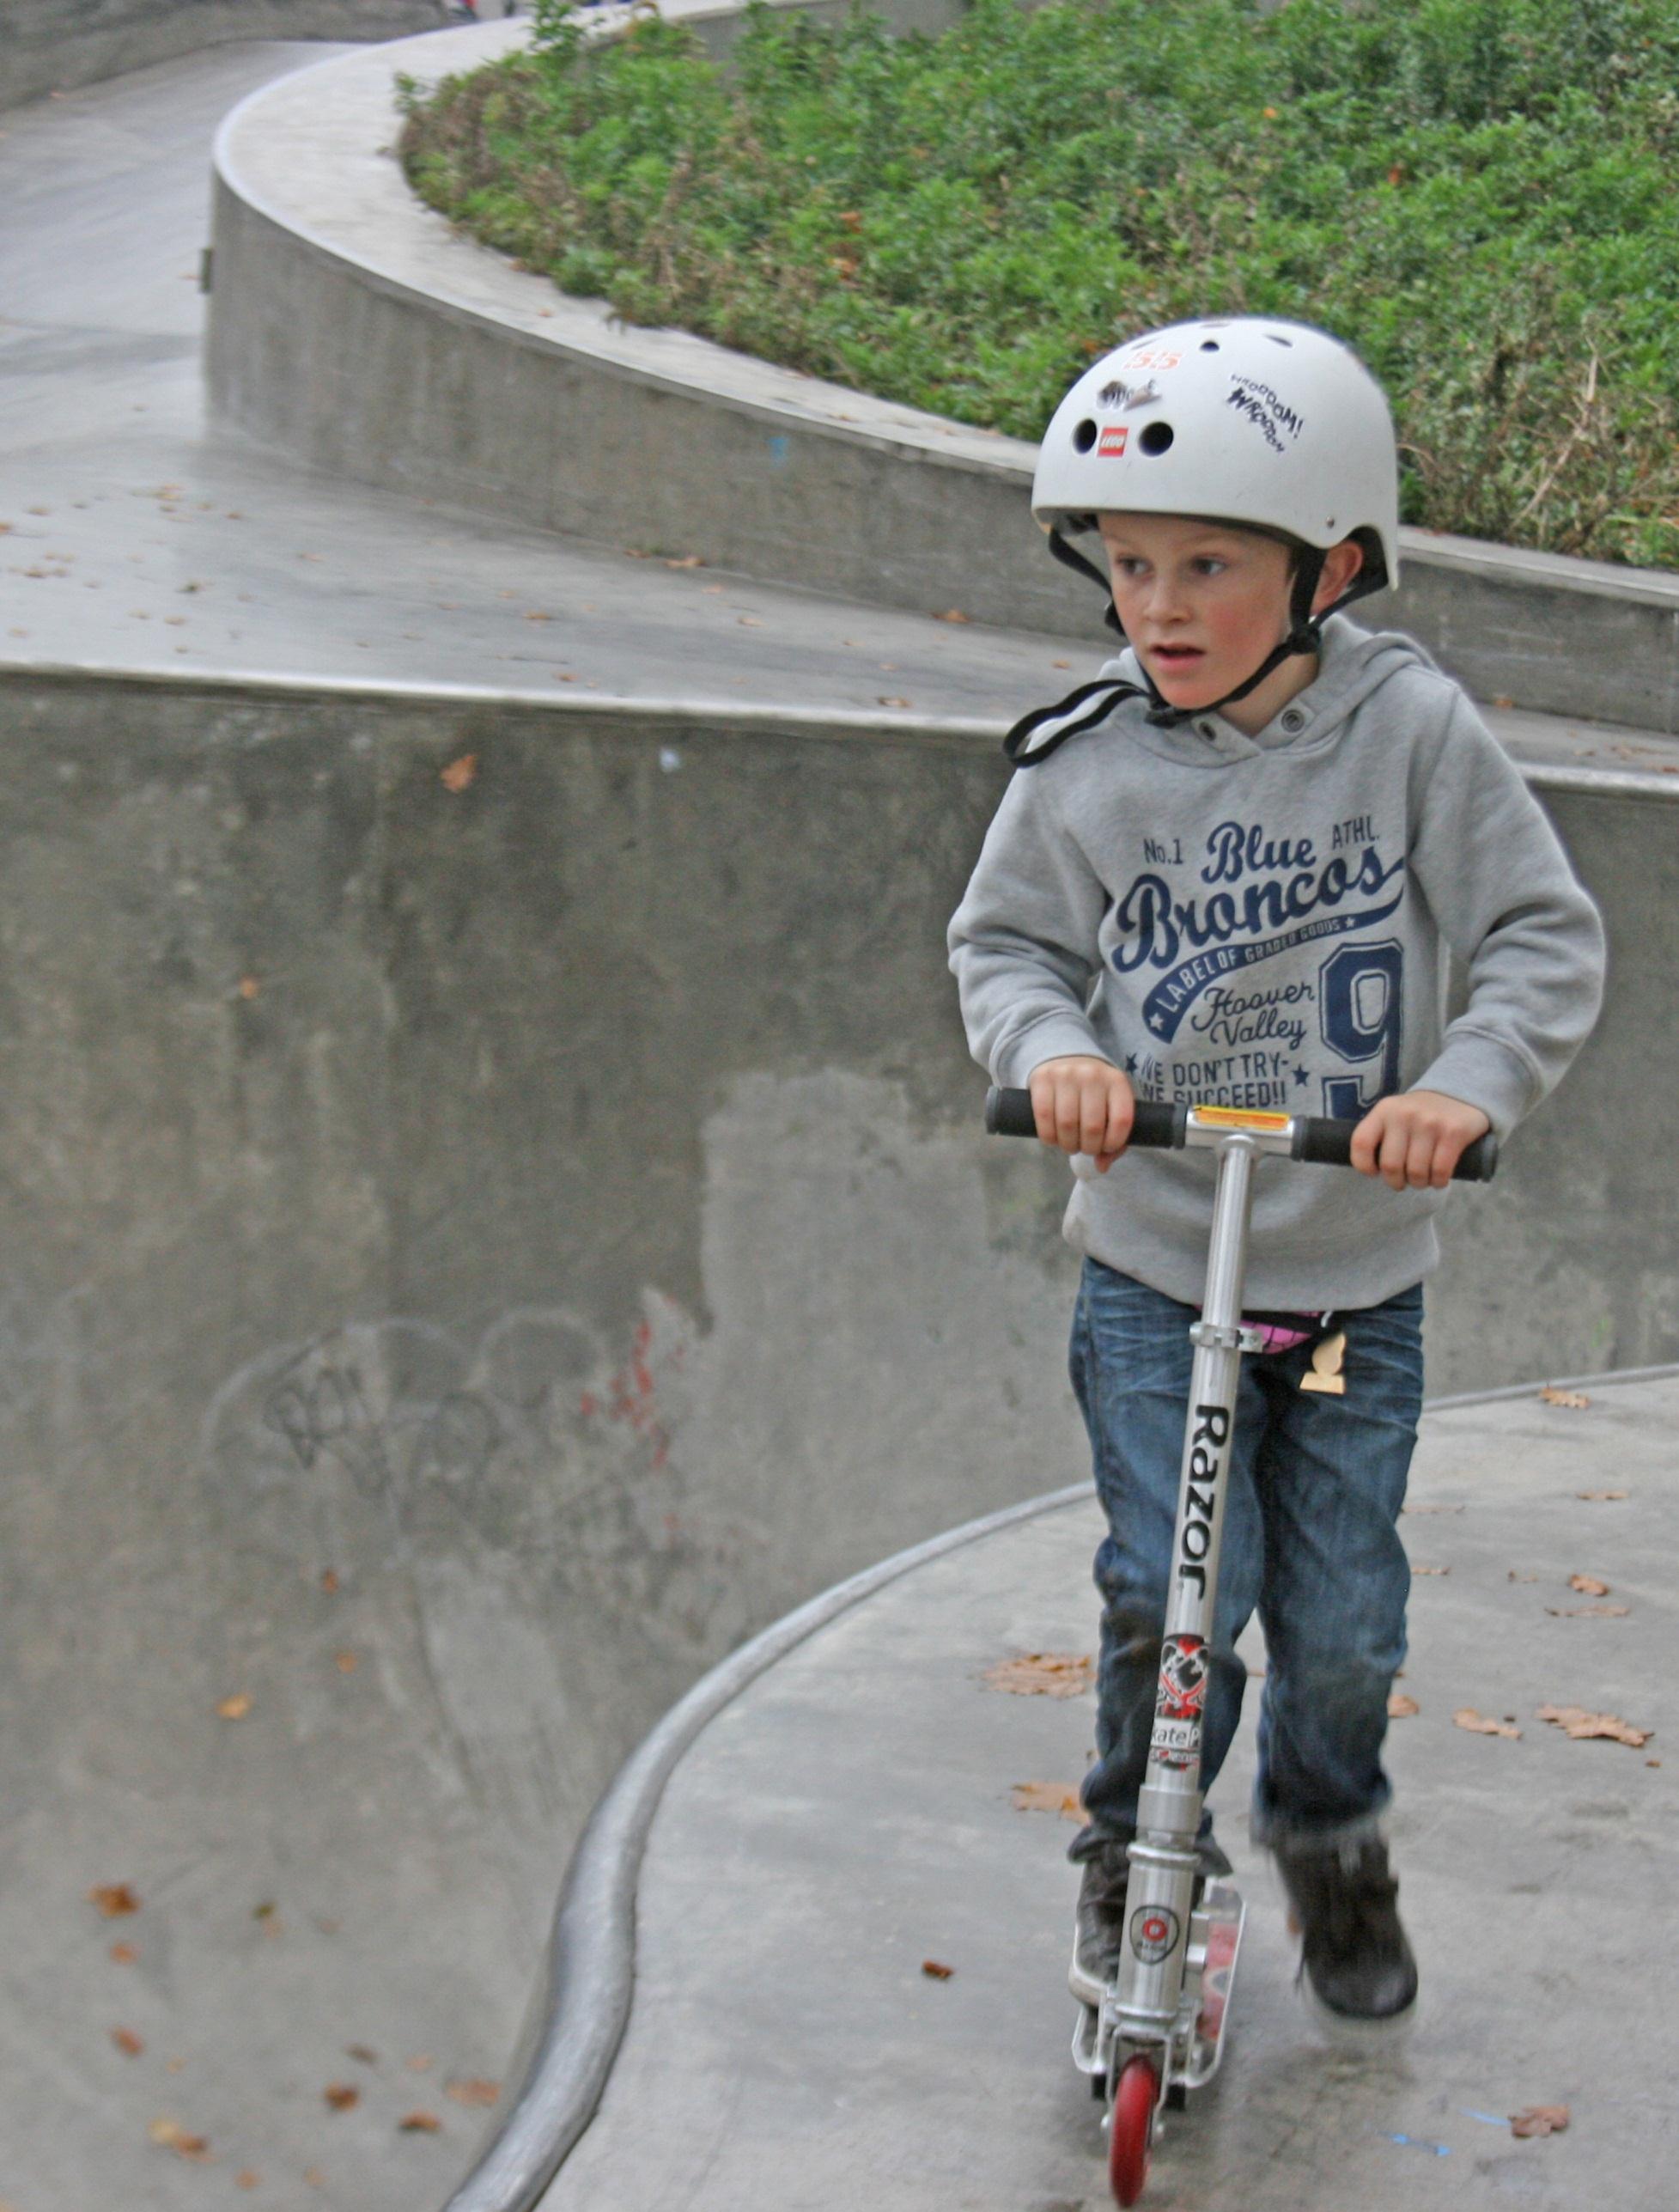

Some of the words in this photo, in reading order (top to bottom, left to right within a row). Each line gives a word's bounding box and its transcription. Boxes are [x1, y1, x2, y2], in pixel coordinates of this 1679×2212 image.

[1143, 838, 1183, 864] No.1
[1201, 821, 1317, 884] Blue
[1111, 845, 1405, 974] Broncos
[1155, 953, 1216, 1014] LABEL
[1216, 948, 1238, 971] OF
[1299, 918, 1341, 941] GOODS
[1191, 982, 1315, 1033] Hoover
[1209, 1008, 1306, 1051] Valley
[1141, 1054, 1164, 1085] WE
[1172, 1057, 1235, 1088] DON'T
[1178, 1405, 1229, 1600] Razor
